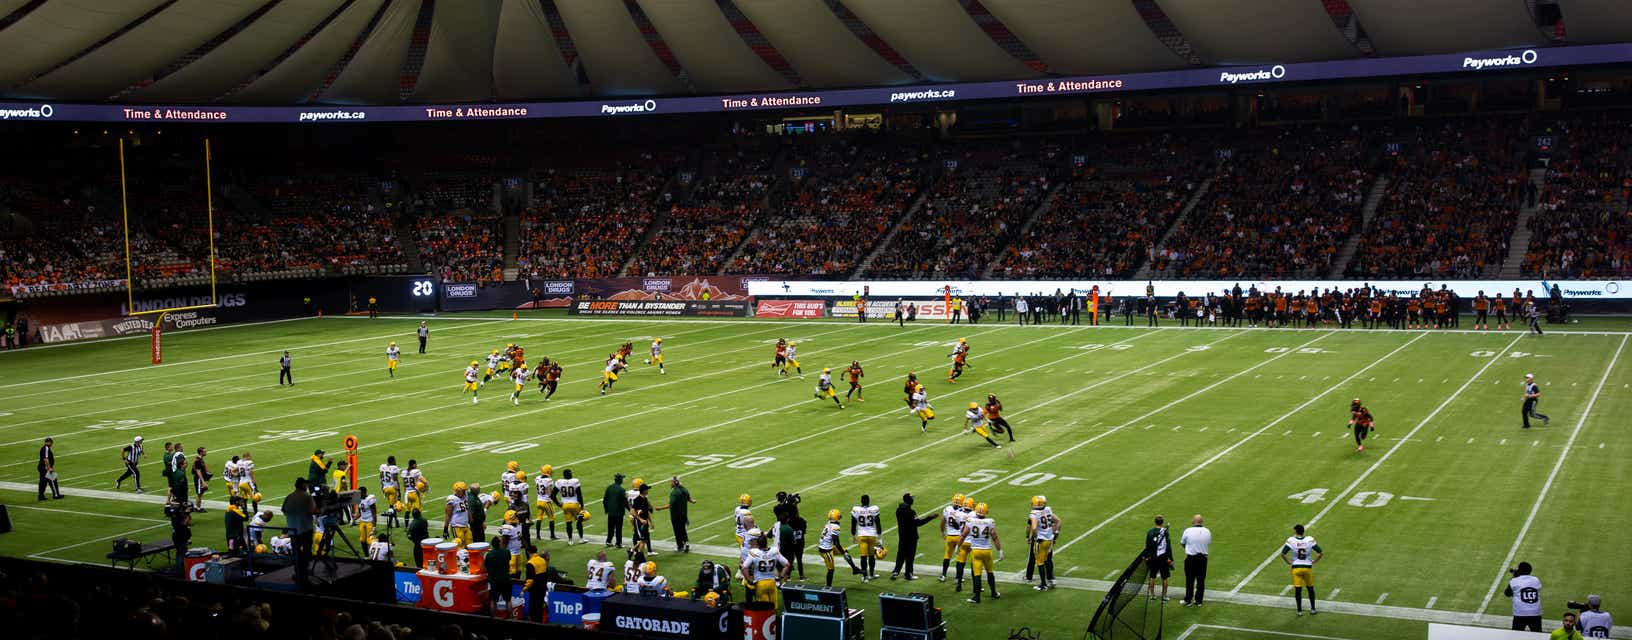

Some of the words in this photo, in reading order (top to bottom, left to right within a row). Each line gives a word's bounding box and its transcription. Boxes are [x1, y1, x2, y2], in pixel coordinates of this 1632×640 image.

[1463, 55, 1521, 69] Payworks
[1219, 69, 1271, 83] Payworks
[1016, 83, 1044, 94] Time
[1047, 82, 1056, 93] &
[1059, 79, 1122, 92] Attendance
[722, 98, 748, 108] Time
[751, 97, 758, 107] &
[761, 95, 821, 107] Attendance
[890, 89, 955, 102] payworks.ca
[0, 107, 41, 119] ayworks
[123, 108, 151, 119] Time
[154, 109, 162, 119] &
[165, 109, 227, 120] Attendance
[426, 108, 453, 118] Time
[456, 108, 463, 117] &
[466, 107, 527, 118] Attendance
[601, 103, 645, 114] Payworks
[300, 111, 366, 122] payworks.ca
[412, 281, 433, 296] 20
[120, 297, 187, 315] LONDON
[190, 293, 247, 309] DRUGS
[577, 302, 590, 310] BE
[590, 302, 617, 310] MORE
[163, 312, 198, 323] Express
[175, 316, 217, 329] Computers
[112, 319, 141, 334] TWISTED
[683, 453, 778, 470] 50
[958, 469, 1057, 487] 50
[1288, 487, 1396, 508] 40
[858, 515, 874, 527] 93
[971, 526, 990, 538] 94
[403, 581, 421, 594] The
[433, 580, 454, 608] G
[1523, 591, 1537, 600] LCF
[553, 600, 573, 615] The
[790, 601, 834, 613] EQUIPMENT
[615, 615, 690, 635] GATORADE
